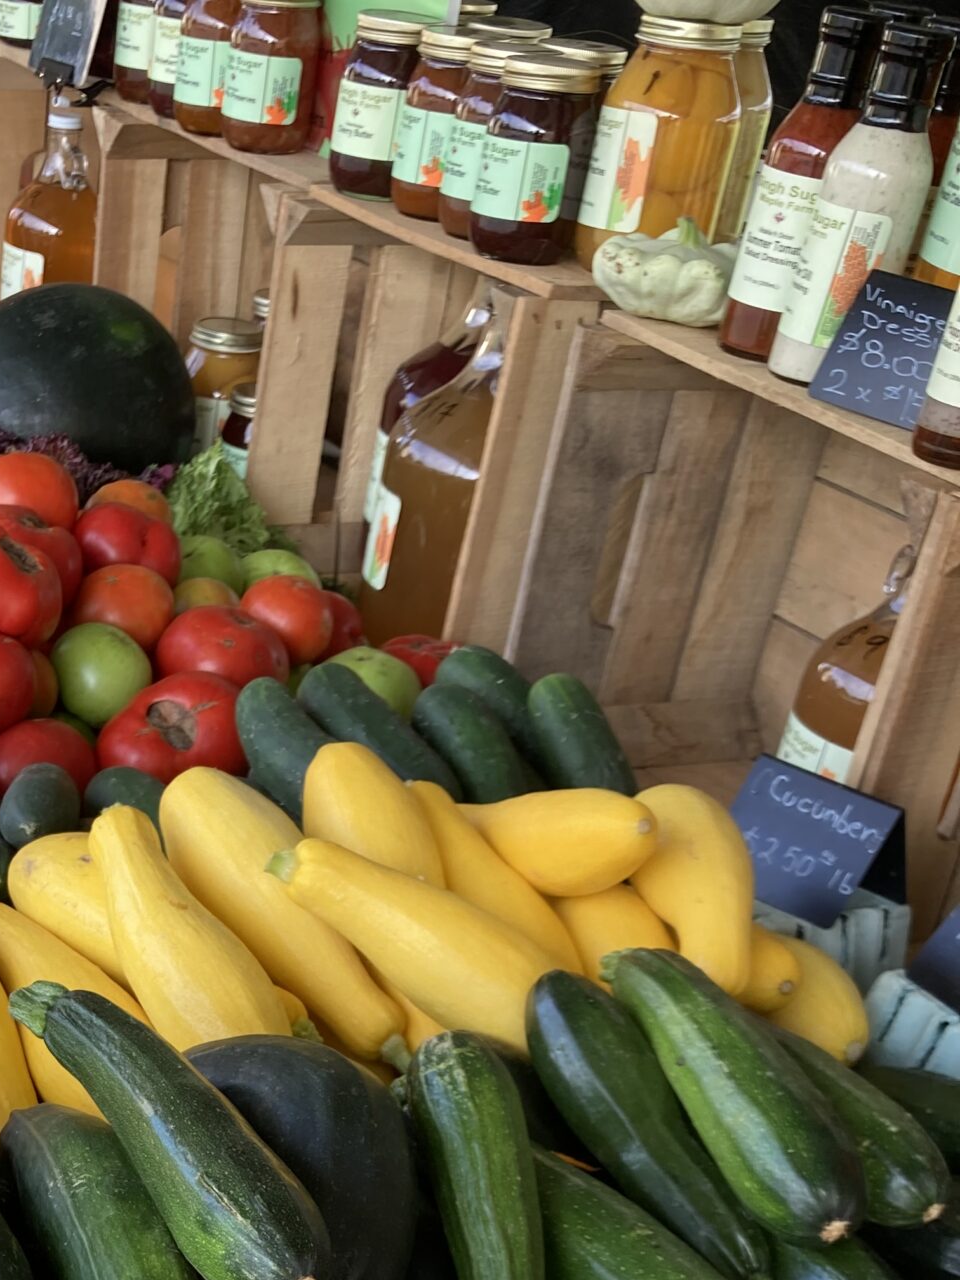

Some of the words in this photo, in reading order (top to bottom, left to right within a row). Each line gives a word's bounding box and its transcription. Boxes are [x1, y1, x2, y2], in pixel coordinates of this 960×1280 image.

[491, 142, 521, 158] Sugar
[789, 185, 818, 206] Sug
[773, 240, 802, 256] Tomat
[822, 368, 848, 396] 2
